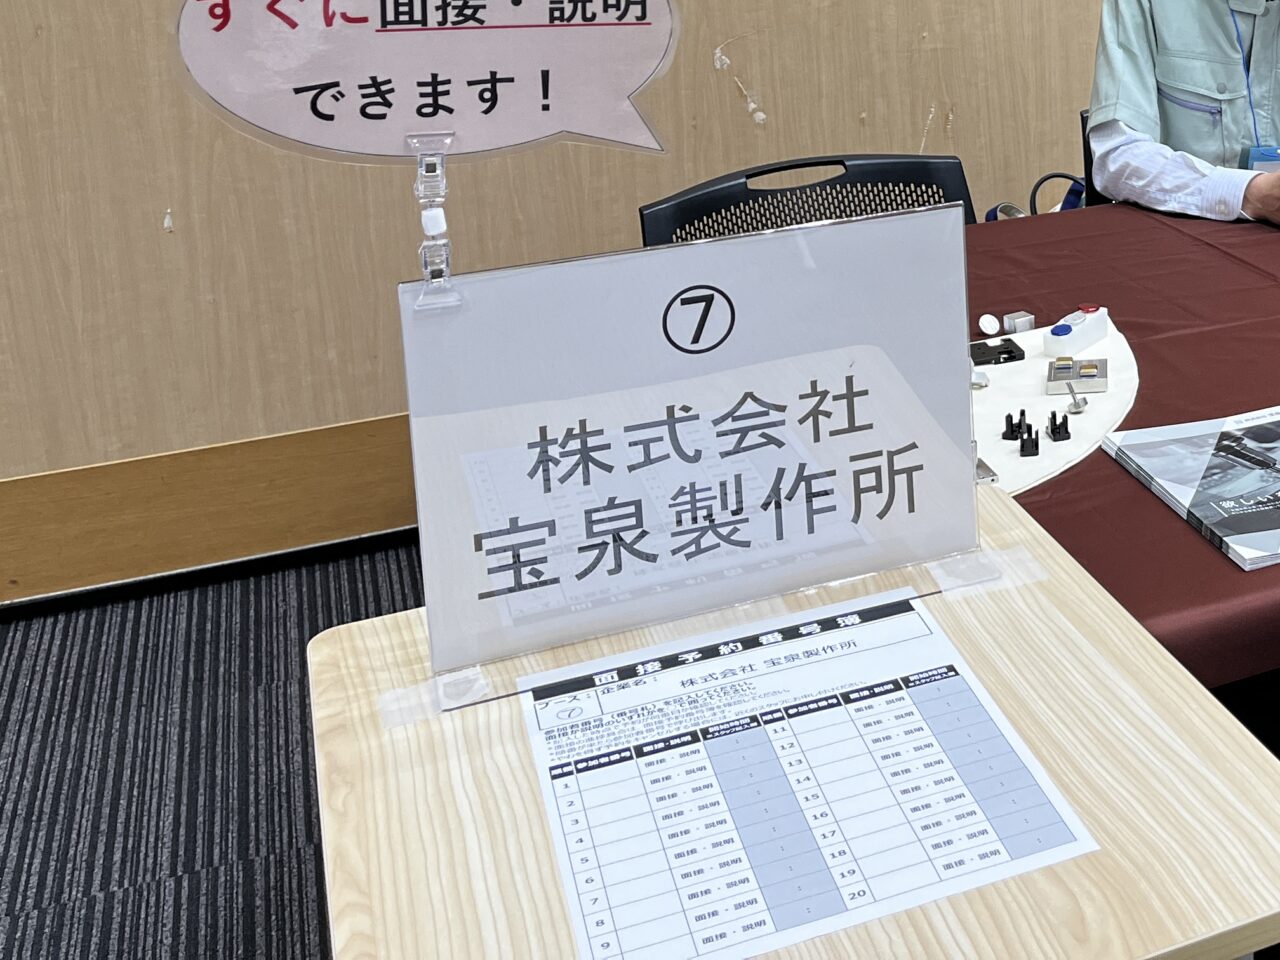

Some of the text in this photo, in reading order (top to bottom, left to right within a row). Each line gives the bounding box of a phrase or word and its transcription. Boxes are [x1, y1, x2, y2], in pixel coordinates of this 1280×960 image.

[526, 374, 874, 494] 株式会社
[472, 441, 924, 601] 宝泉製作所
[772, 726, 787, 734] 11
[779, 742, 795, 751] 12
[787, 759, 803, 768] 13
[795, 775, 811, 784] 14
[803, 793, 820, 803] 15
[811, 811, 829, 821] 16
[820, 830, 837, 840] 17
[829, 849, 847, 859] 18
[838, 868, 856, 879] 19
[847, 889, 867, 900] 20
